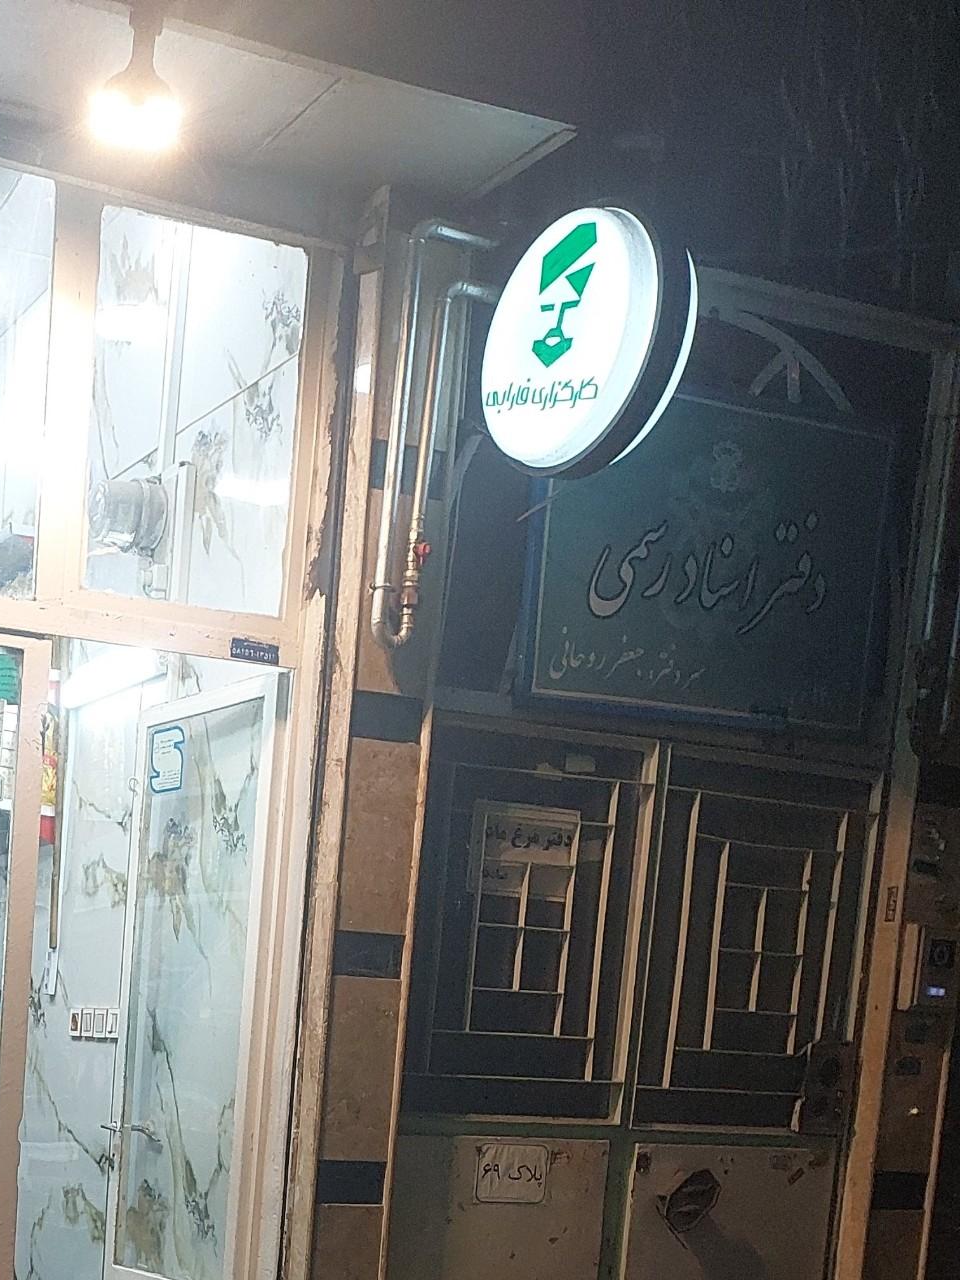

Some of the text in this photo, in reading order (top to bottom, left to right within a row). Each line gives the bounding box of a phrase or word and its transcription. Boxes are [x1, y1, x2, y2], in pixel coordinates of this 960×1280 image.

[486, 376, 599, 414] کارگزاری فارابی
[588, 519, 674, 620] رسمی
[738, 511, 827, 635] دفتر
[481, 1163, 543, 1188] پلاک ۶۹
